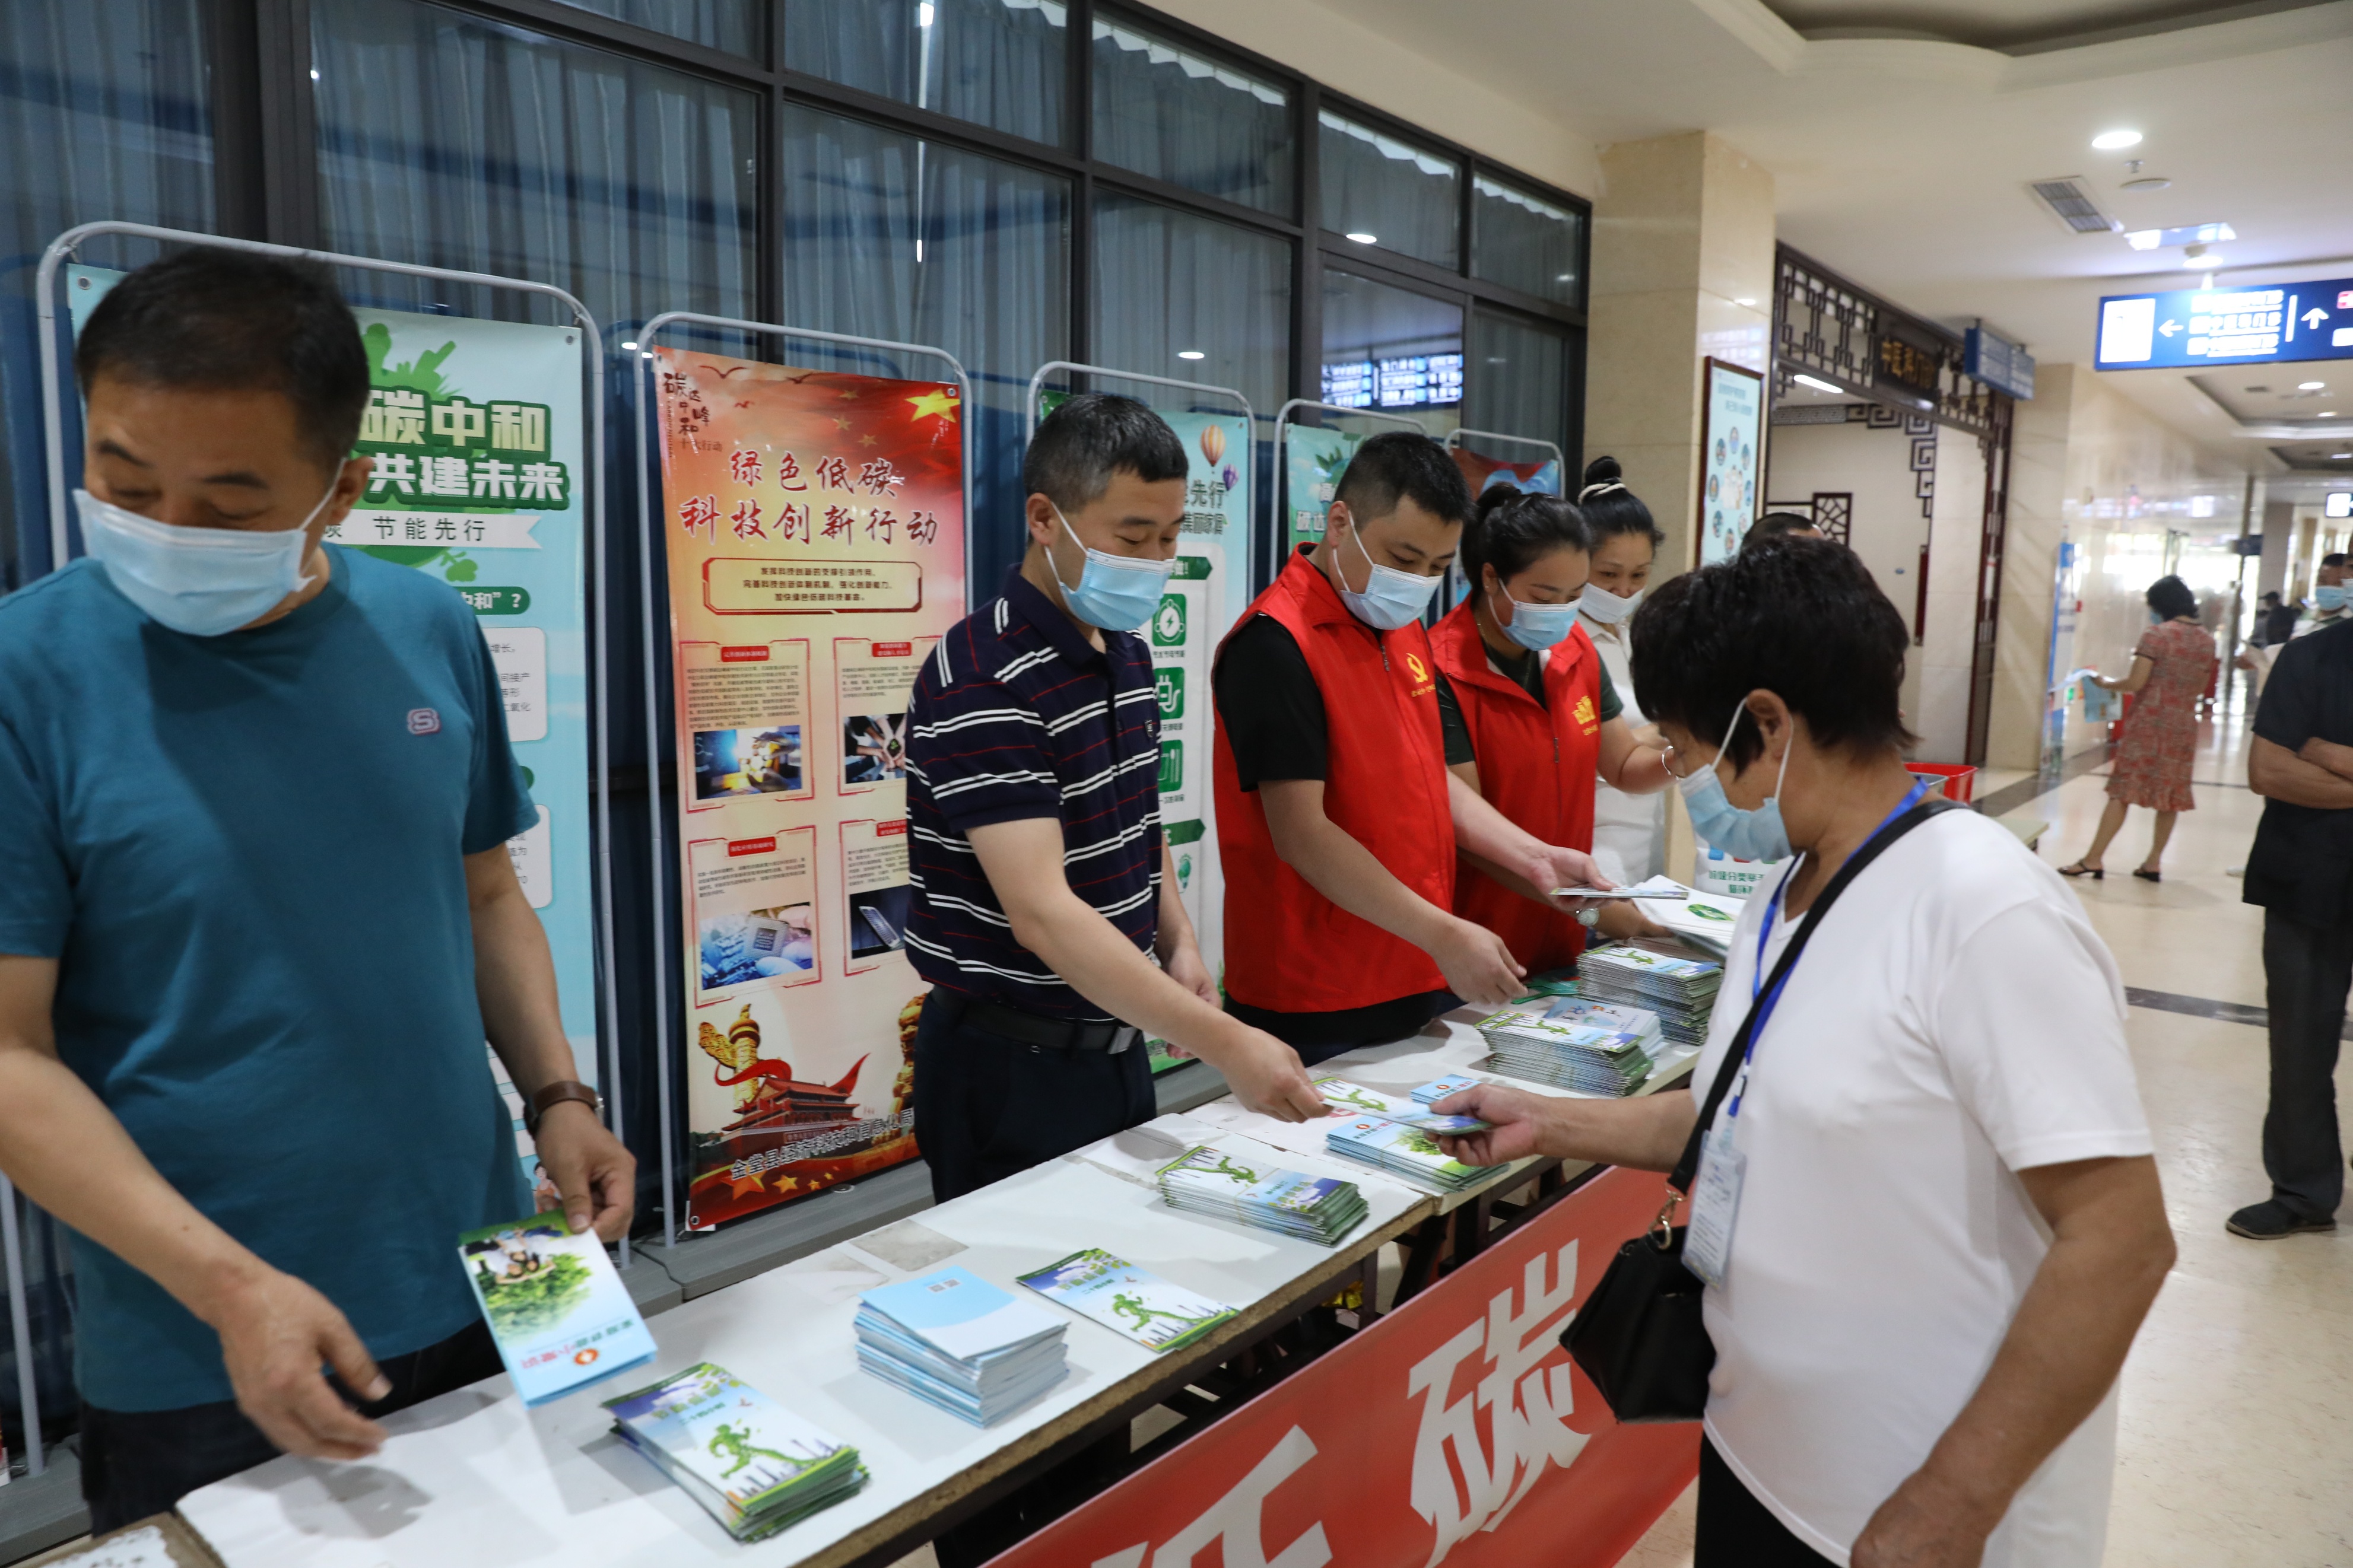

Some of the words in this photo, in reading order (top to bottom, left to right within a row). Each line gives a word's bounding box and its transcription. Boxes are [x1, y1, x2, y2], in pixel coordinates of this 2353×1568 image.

[369, 452, 564, 500] 共建未来
[729, 450, 904, 497] 绿色低碳
[1183, 479, 1225, 508] 先行
[373, 517, 487, 541] 节能先行
[678, 495, 939, 546] 科技创新行动
